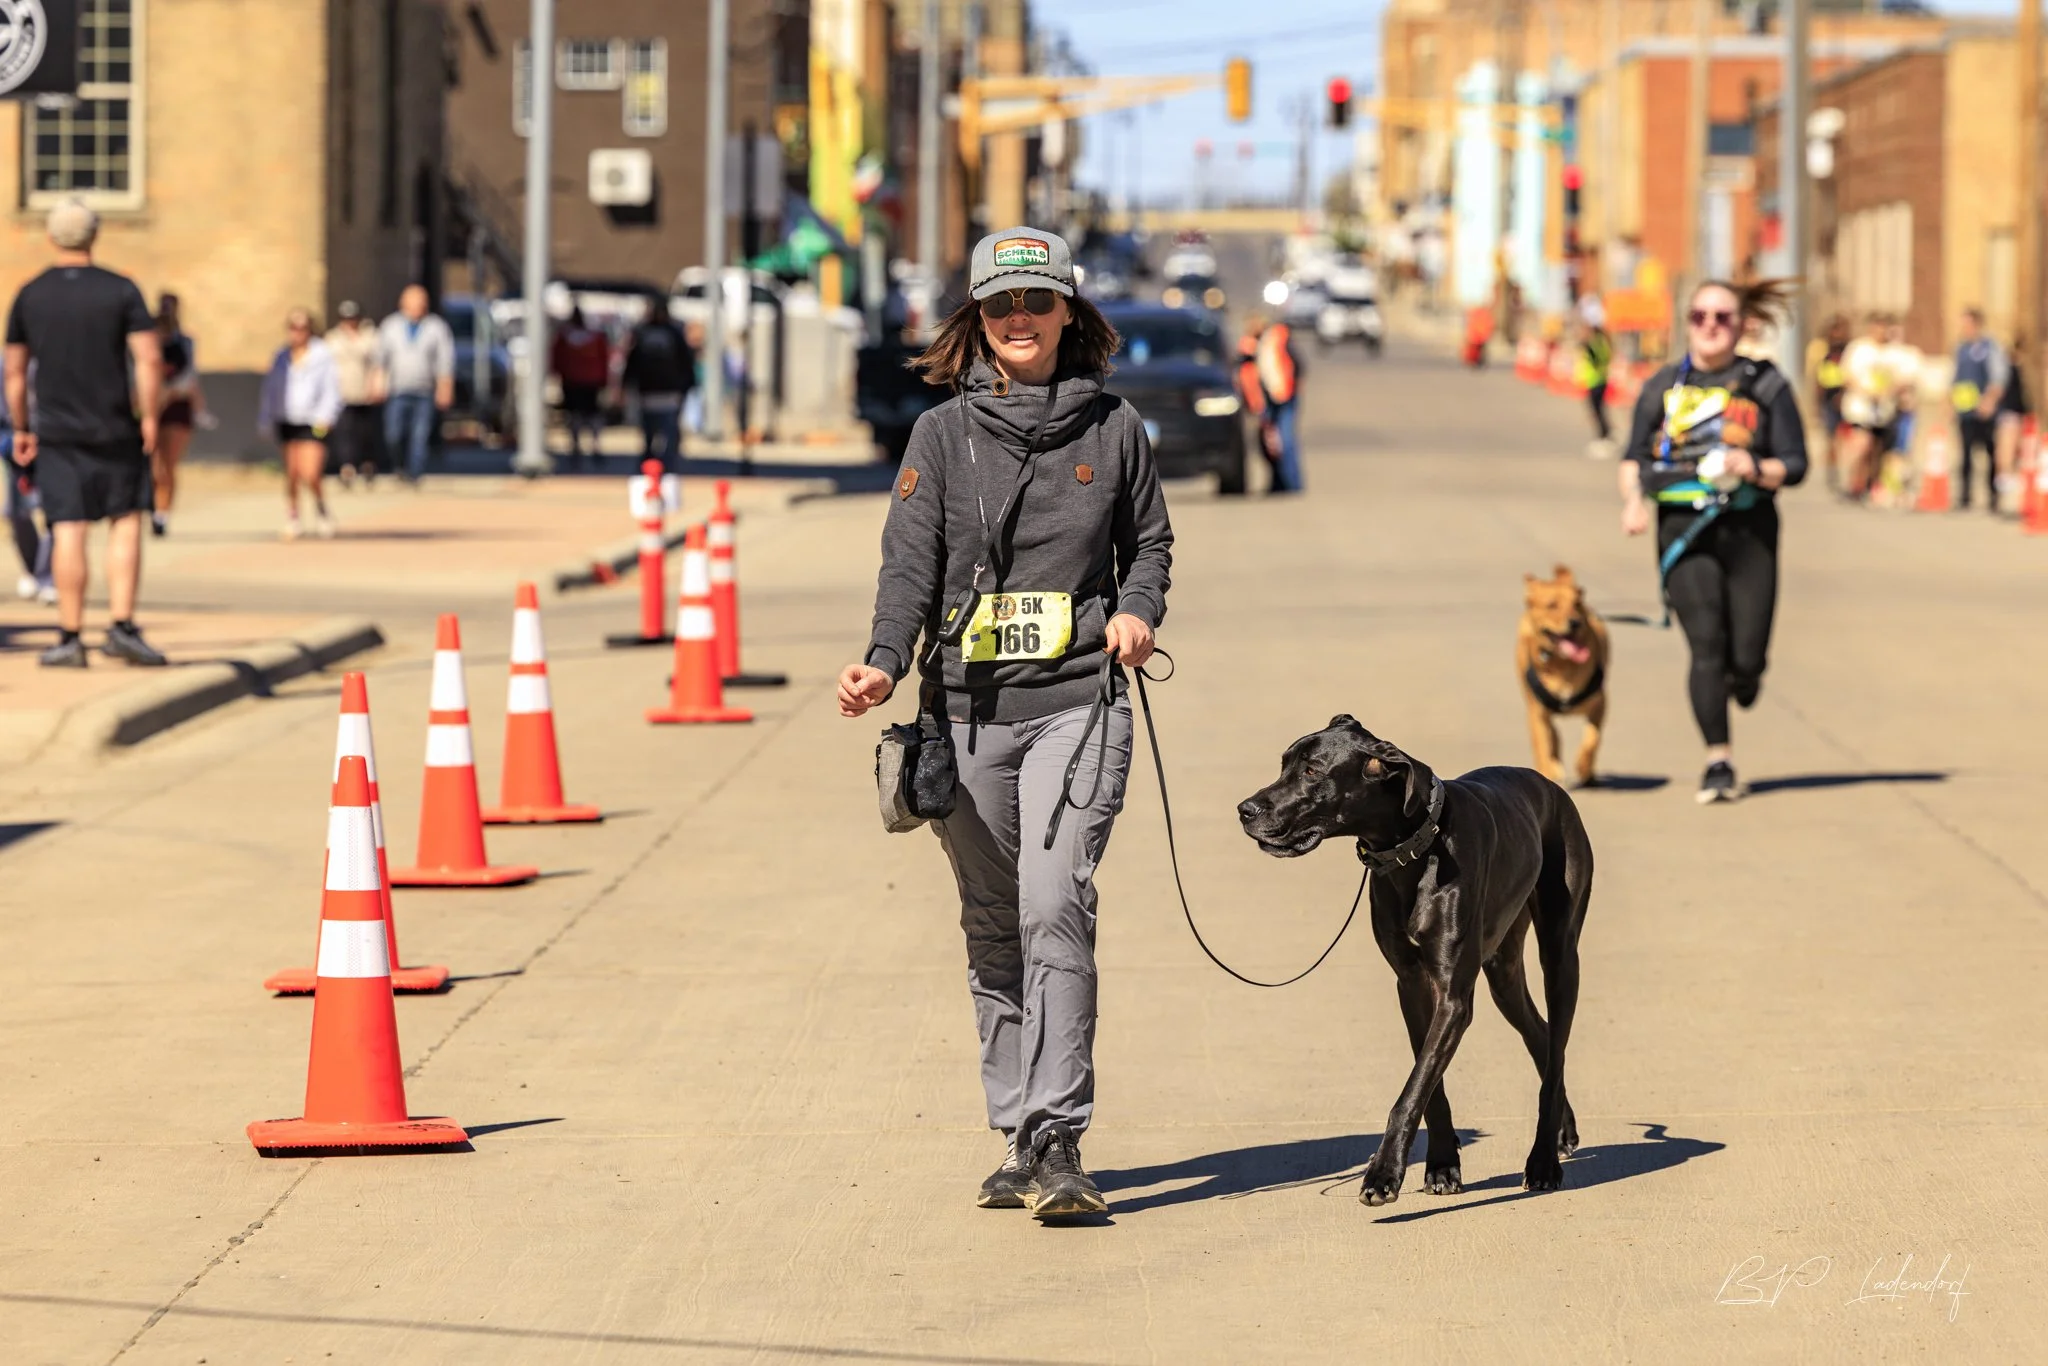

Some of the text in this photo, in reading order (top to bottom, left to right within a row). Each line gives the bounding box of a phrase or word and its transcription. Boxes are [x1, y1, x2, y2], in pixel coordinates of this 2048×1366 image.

[997, 248, 1046, 259] SCHEELS
[1021, 597, 1043, 614] 5K
[991, 622, 1040, 655] 166
